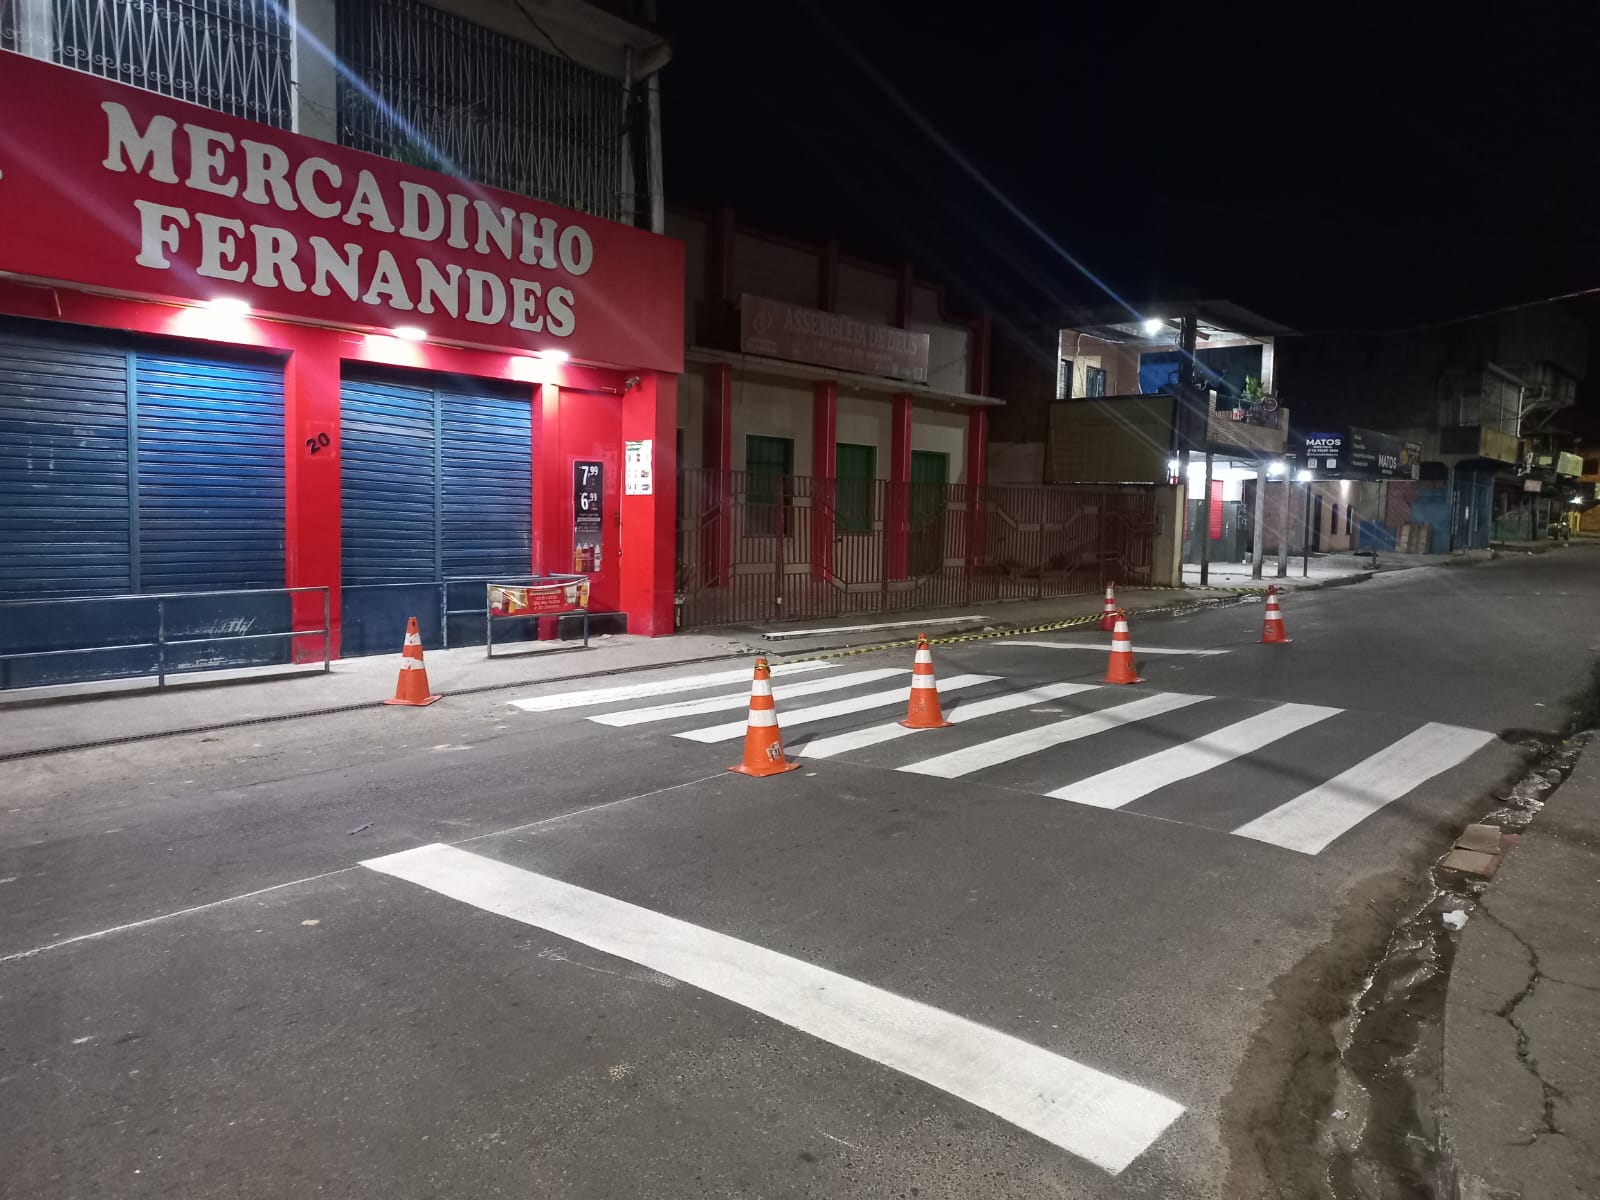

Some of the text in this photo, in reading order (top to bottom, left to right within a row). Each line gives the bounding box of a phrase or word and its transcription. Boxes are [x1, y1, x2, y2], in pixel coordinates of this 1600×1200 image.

[101, 101, 594, 276] MERCADINHO
[134, 200, 577, 338] FERNANDES
[305, 432, 330, 455] 20
[1306, 438, 1342, 446] MATOS
[1378, 453, 1398, 470] MATOS
[581, 465, 599, 486] 7,99
[580, 492, 598, 511] 6,99
